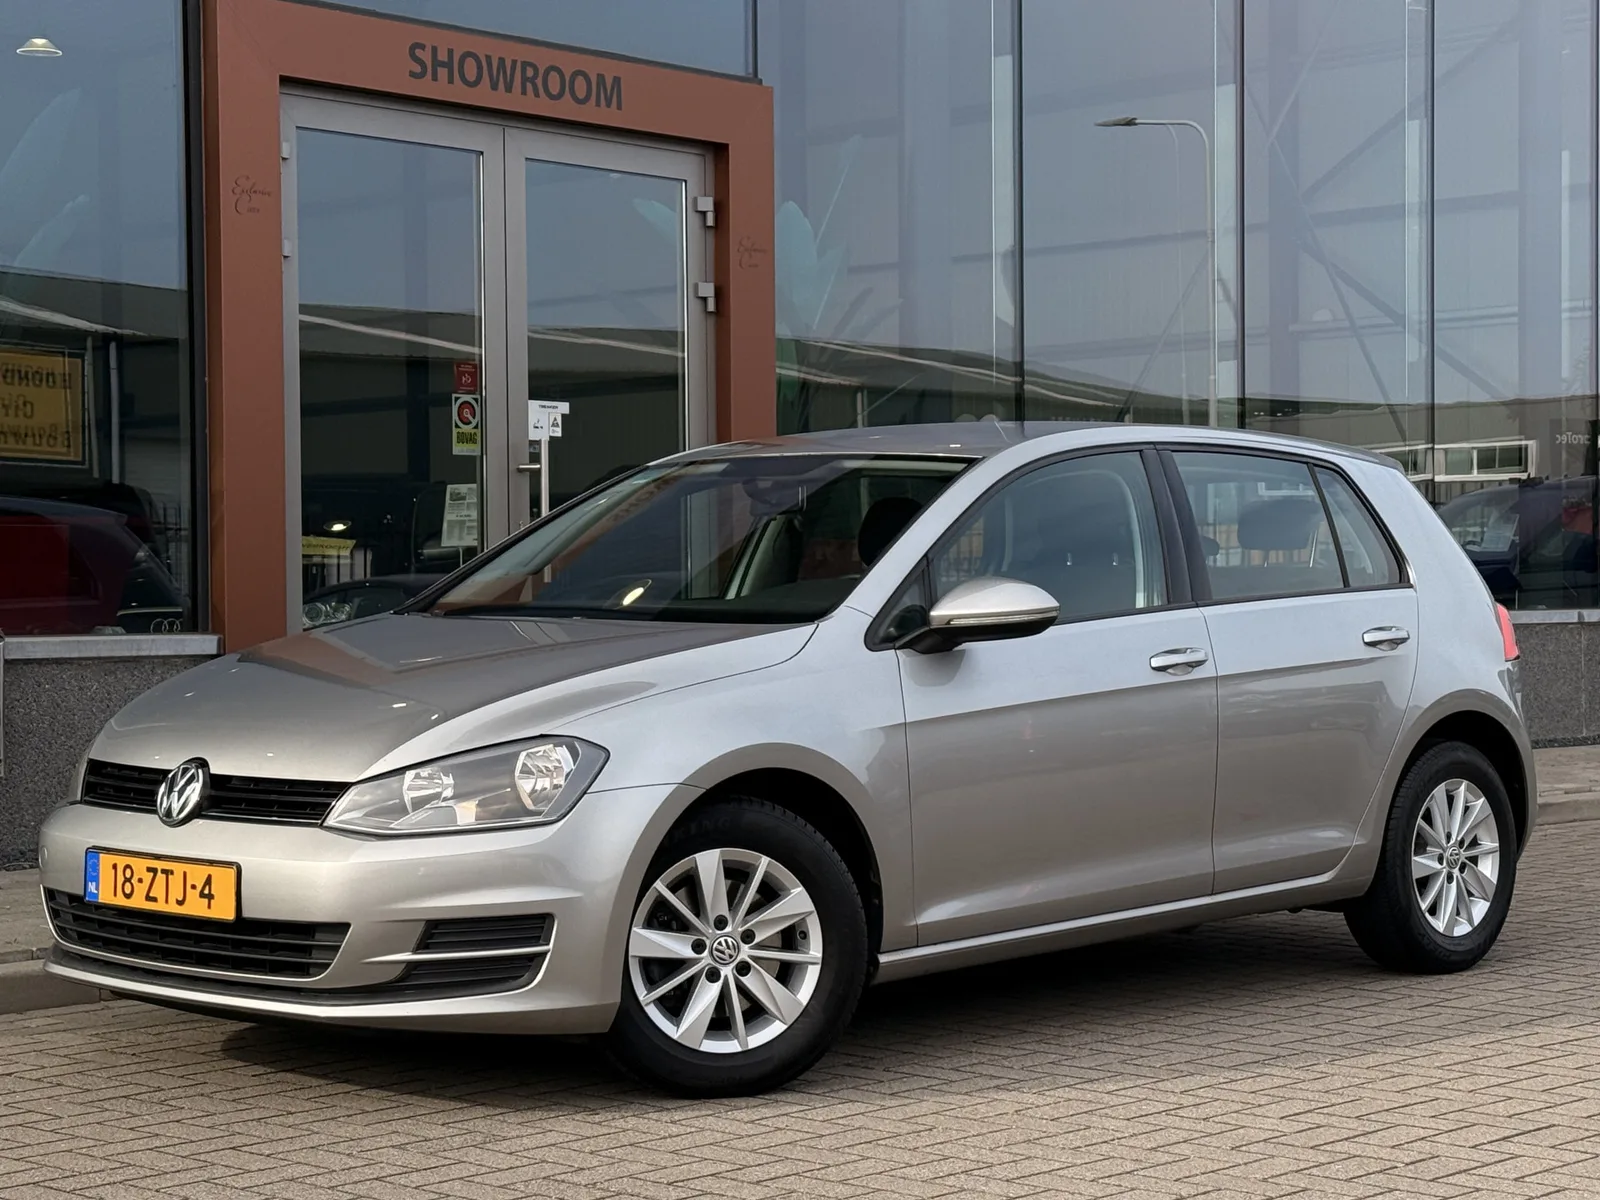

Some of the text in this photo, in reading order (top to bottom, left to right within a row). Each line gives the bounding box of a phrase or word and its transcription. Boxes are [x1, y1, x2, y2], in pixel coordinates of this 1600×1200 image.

[408, 41, 623, 112] SHOWROOM
[456, 431, 478, 445] BOVAG
[88, 881, 98, 894] NL
[111, 862, 215, 910] 18-ZTJ-4
